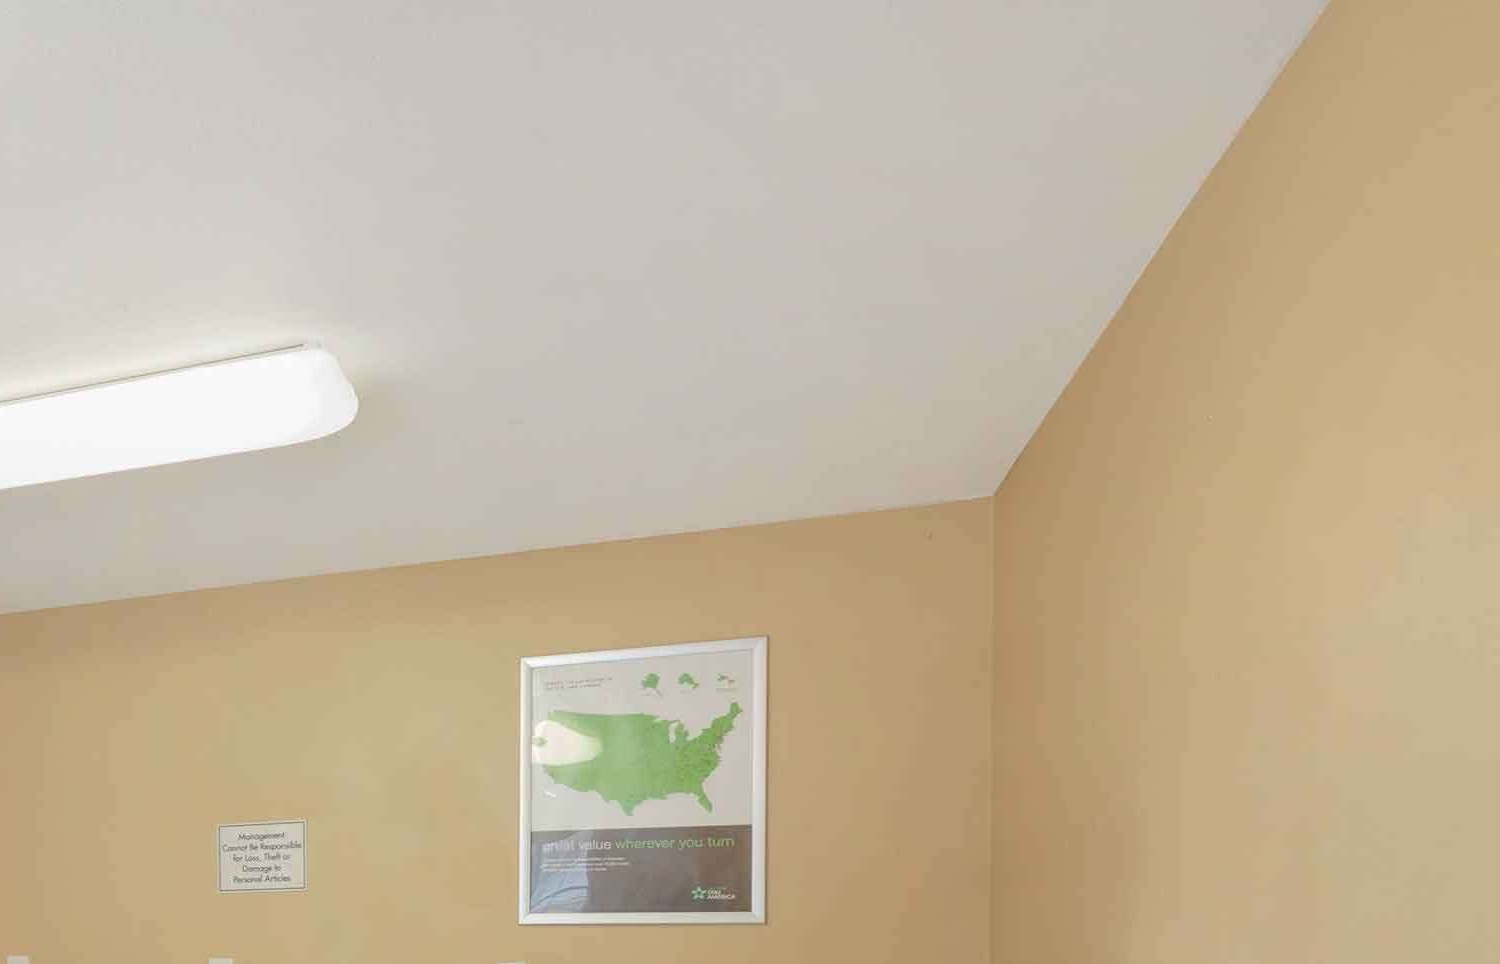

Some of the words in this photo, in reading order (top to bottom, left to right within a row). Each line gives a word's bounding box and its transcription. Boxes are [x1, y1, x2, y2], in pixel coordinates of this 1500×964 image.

[238, 832, 285, 842] Management
[222, 844, 248, 852] Cannot
[249, 843, 259, 851] Be
[260, 840, 302, 851] Responsible
[615, 838, 675, 850] wherever
[678, 838, 704, 851] you
[707, 836, 735, 848] turn
[233, 854, 243, 862] for
[264, 853, 281, 861] Theft
[242, 864, 272, 874] Damage
[233, 874, 262, 884] Personal
[264, 874, 291, 882] Articles
